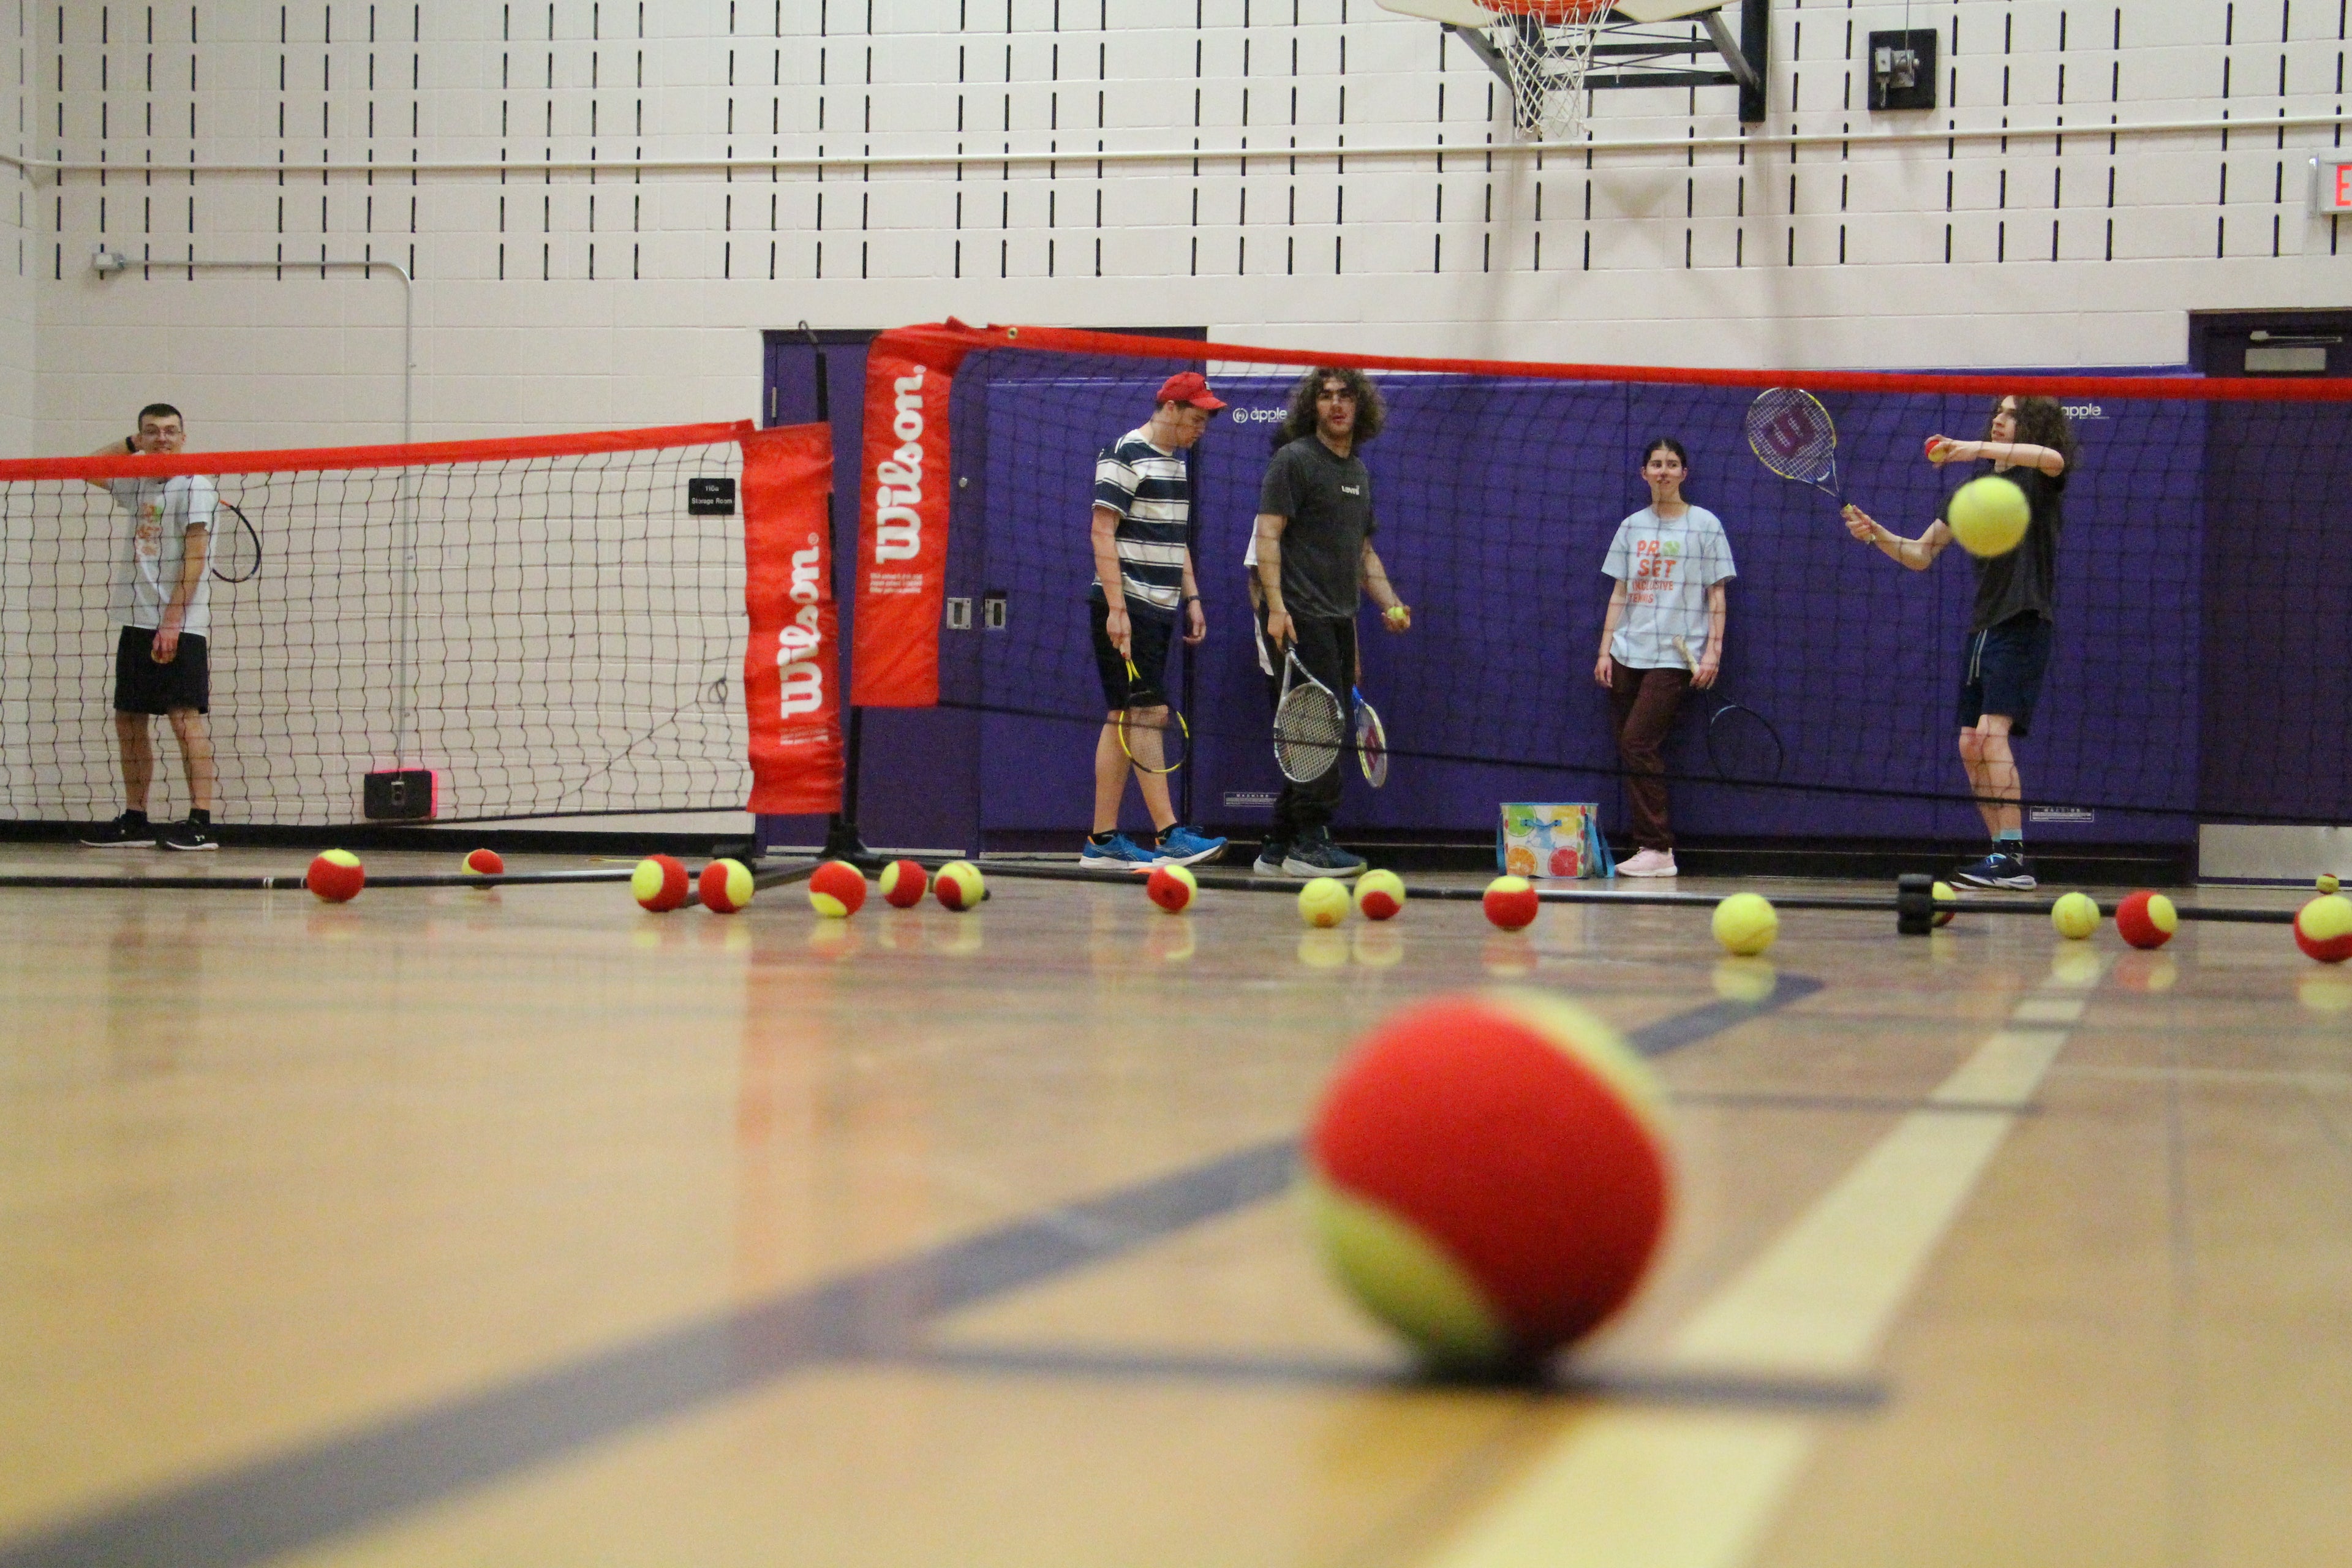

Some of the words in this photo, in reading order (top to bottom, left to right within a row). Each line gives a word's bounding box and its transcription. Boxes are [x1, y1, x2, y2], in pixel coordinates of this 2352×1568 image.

[1250, 407, 1287, 423] apple
[876, 374, 924, 564] Wilson
[1637, 559, 1676, 578] SET
[777, 544, 823, 719] Wilson
